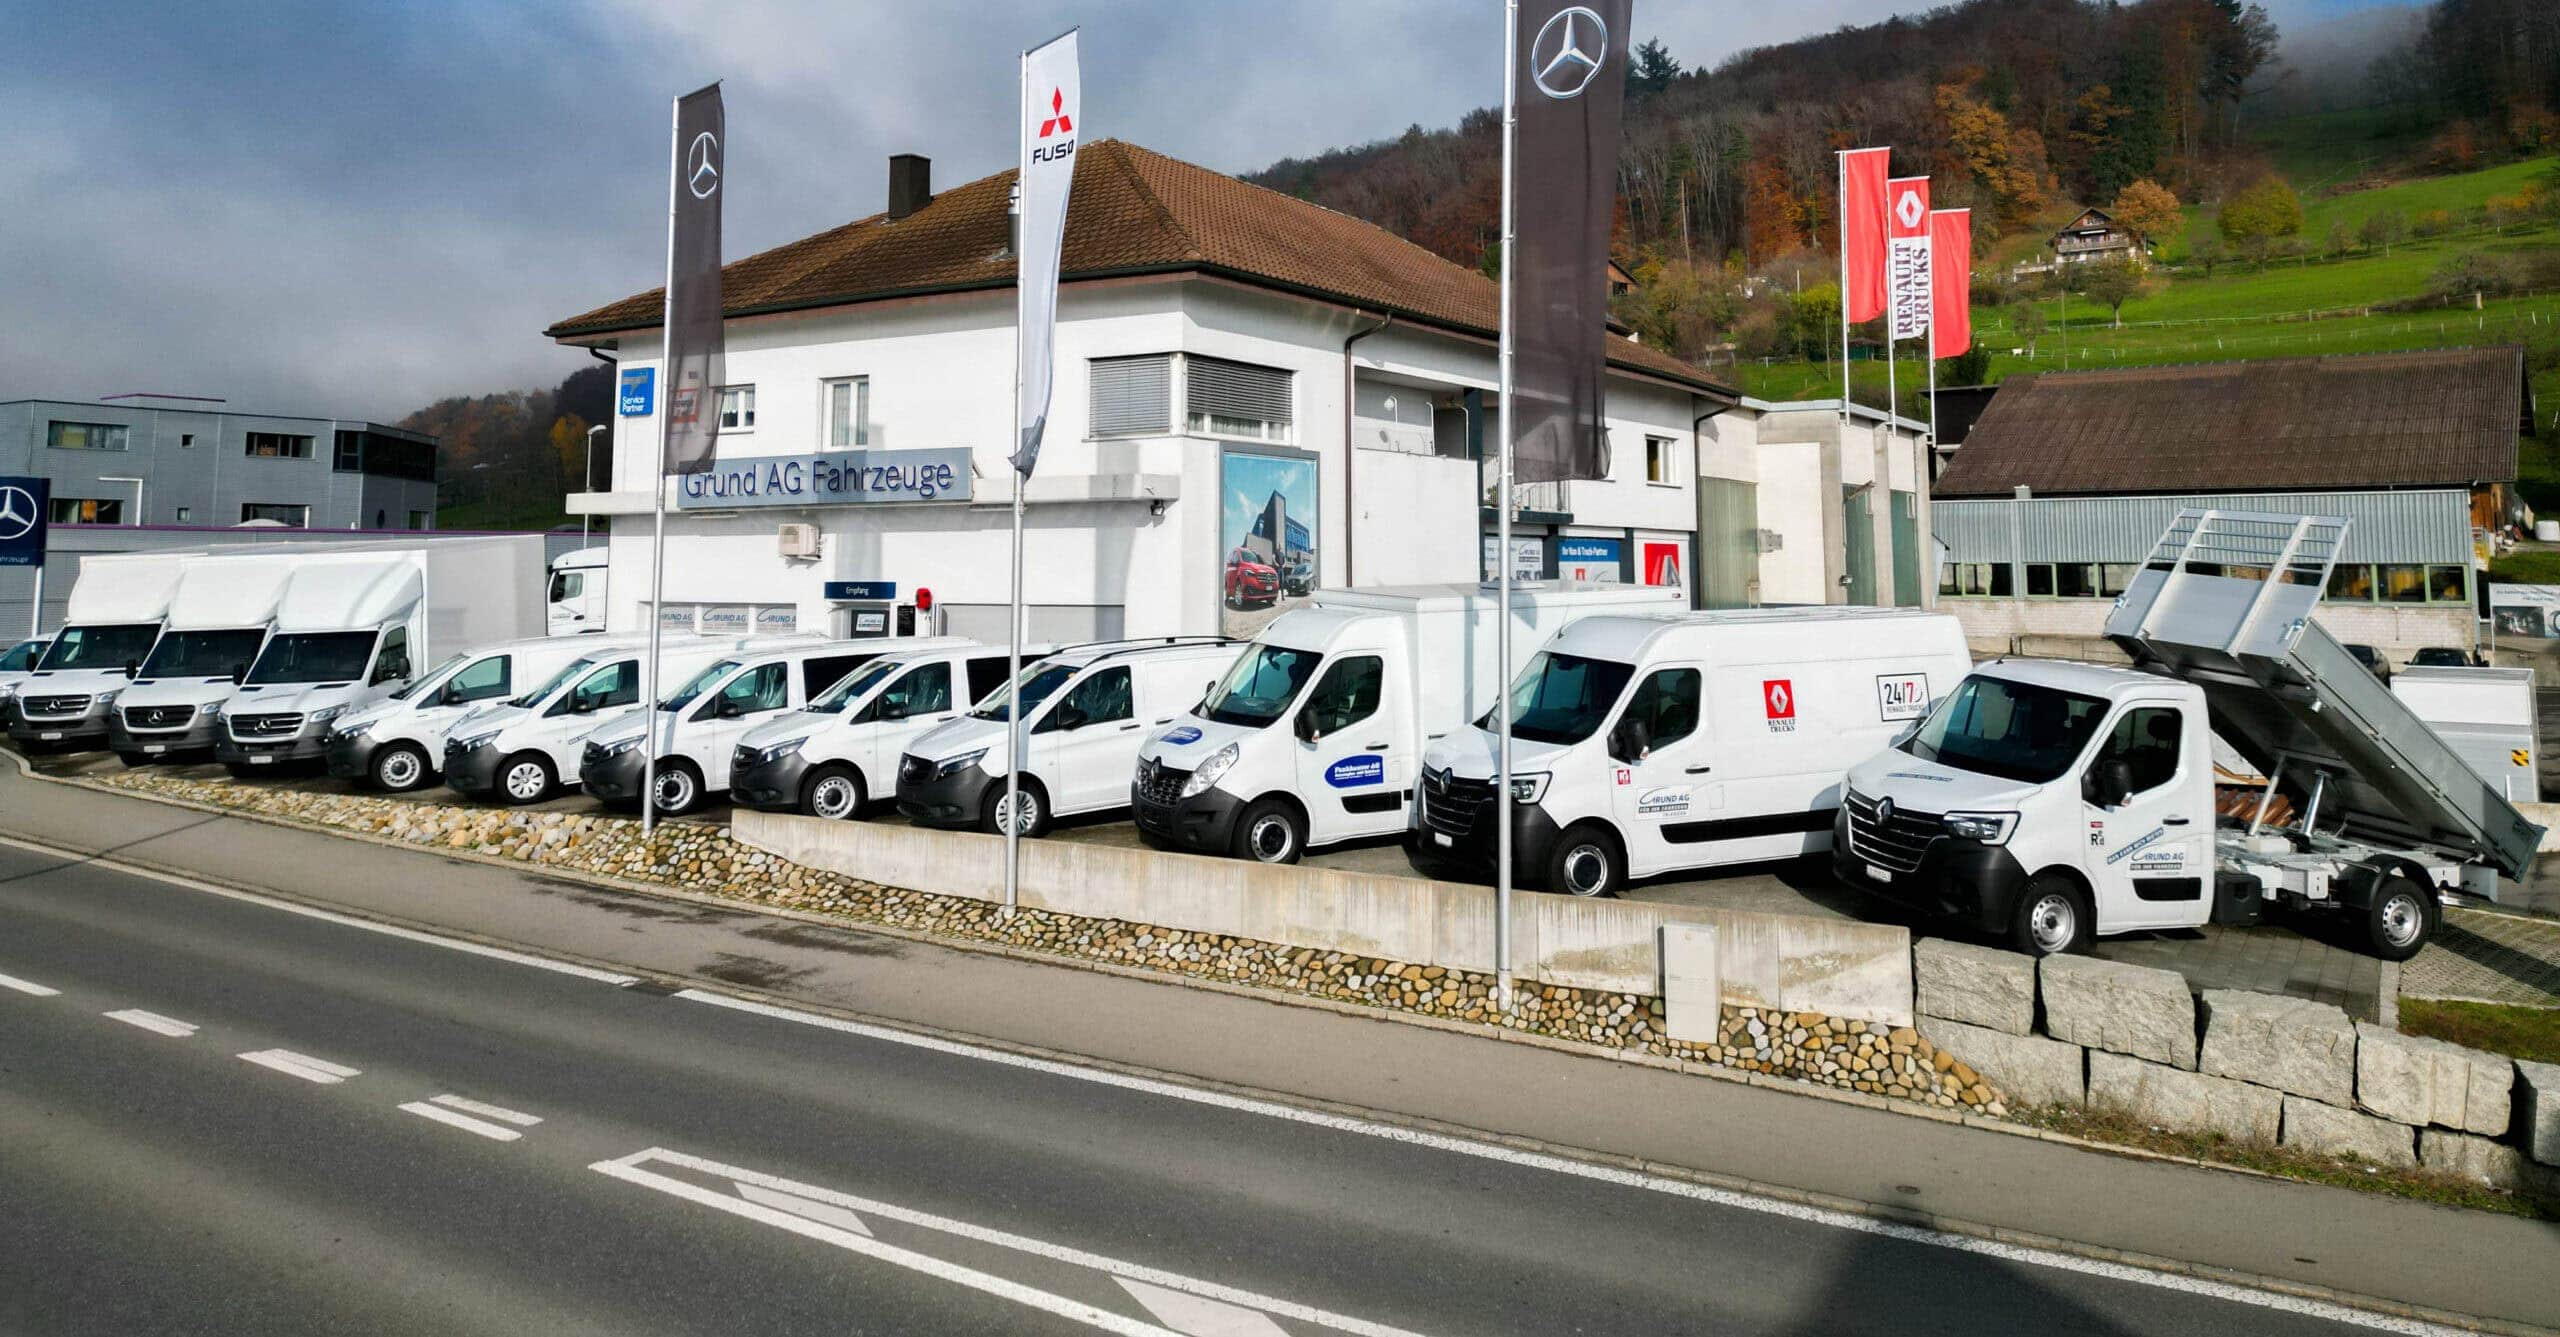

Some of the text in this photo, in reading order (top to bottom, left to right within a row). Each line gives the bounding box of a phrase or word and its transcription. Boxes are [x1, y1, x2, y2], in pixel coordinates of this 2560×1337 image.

[1032, 139, 1075, 165] FUSO
[1895, 244, 1912, 334] RENAULT
[1912, 248, 1929, 329] TRUCKS
[622, 396, 645, 405] Service
[622, 404, 644, 413] Partner
[685, 459, 953, 499] Grund AG Fahrzeuge
[845, 586, 870, 596] Empfang
[661, 613, 693, 621] RUND AG
[1767, 719, 1796, 727] RENAULT
[1770, 725, 1795, 733] TRUCKS
[1678, 794, 1690, 802] AG
[2171, 852, 2185, 861] AG
